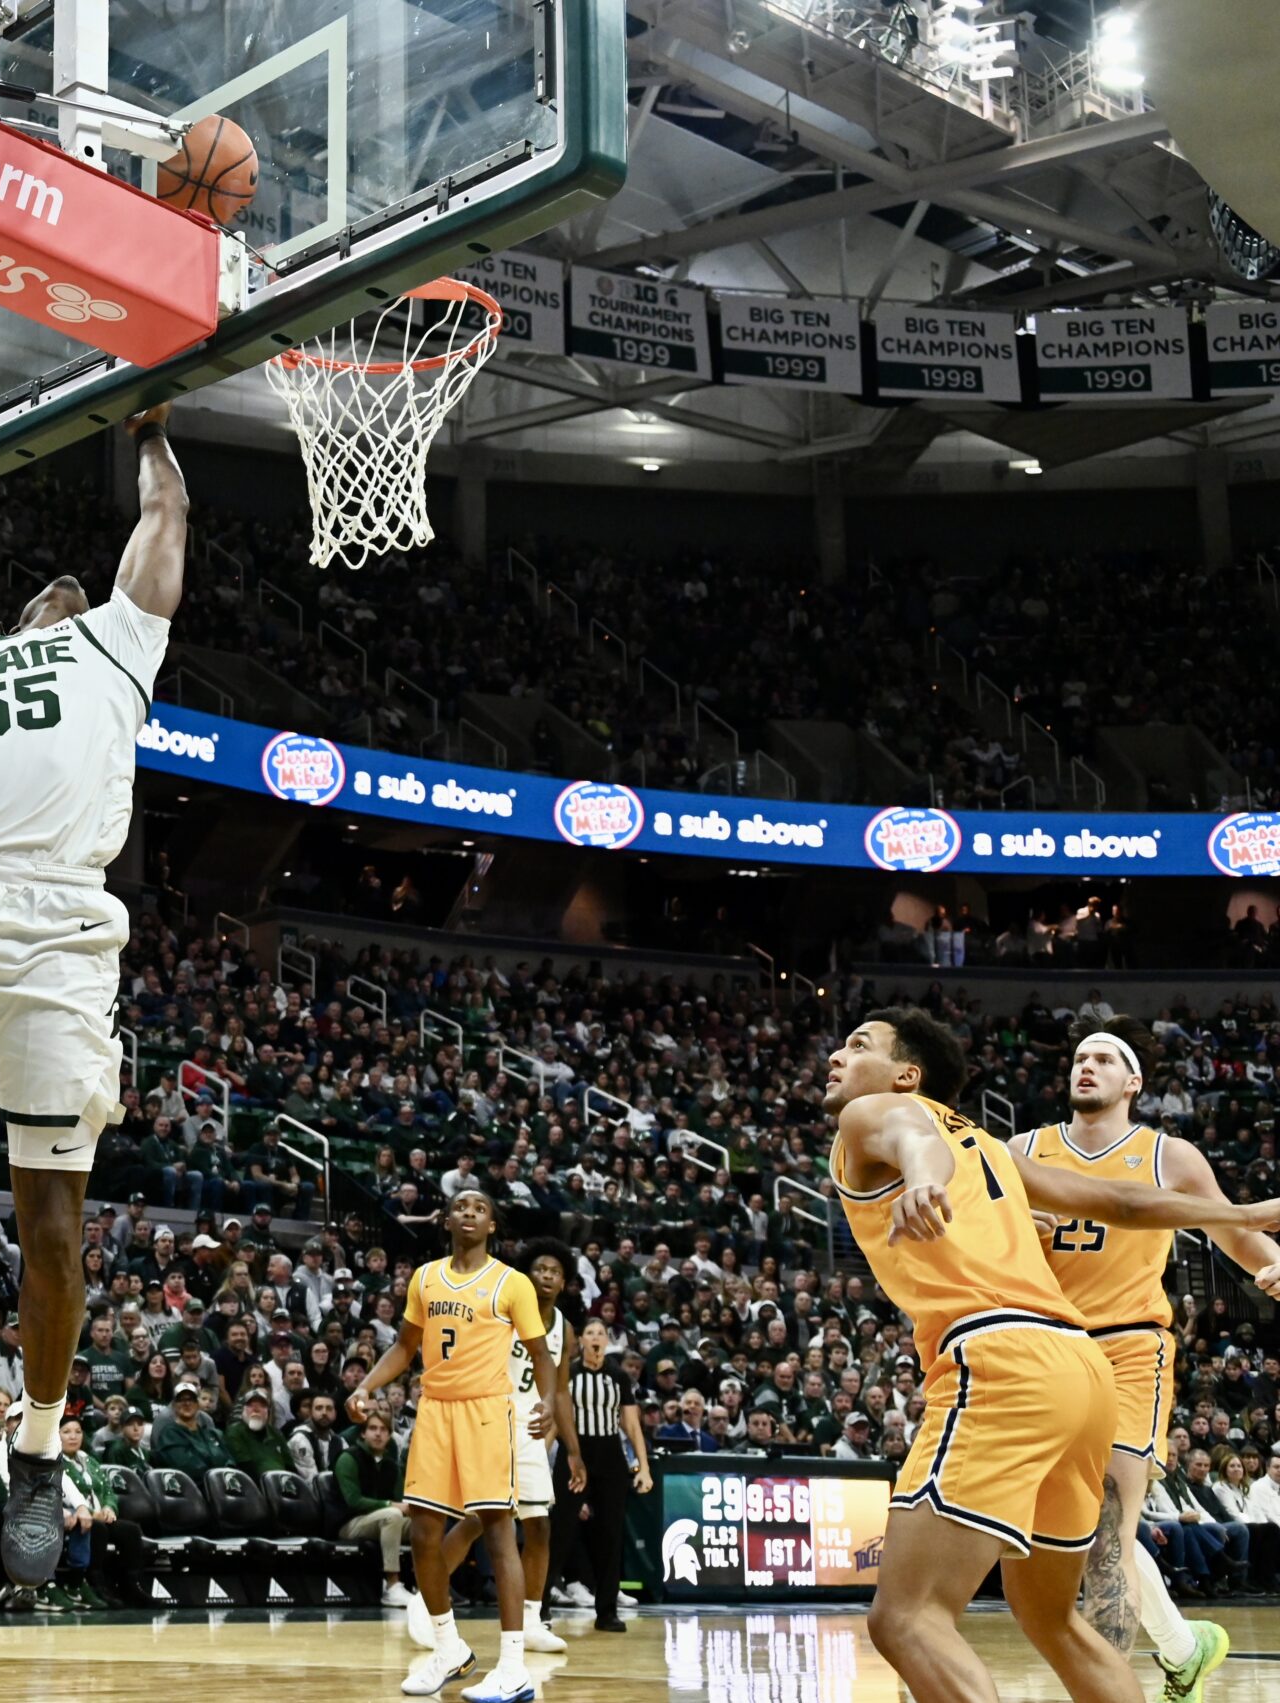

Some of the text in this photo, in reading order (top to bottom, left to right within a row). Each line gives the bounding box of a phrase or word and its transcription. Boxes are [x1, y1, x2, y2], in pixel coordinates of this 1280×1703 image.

[467, 257, 537, 282] IG TEN
[589, 294, 692, 325] TOURNAMENT
[749, 306, 832, 328] BIG TEN
[1238, 312, 1278, 330] BIG
[588, 311, 695, 343] CHAMPIONS
[726, 325, 857, 351] CHAMPIONS
[905, 316, 986, 337] BIG TEN
[1066, 318, 1155, 337] BIG TEN
[612, 337, 671, 366] 1999
[881, 337, 1013, 360] CHAMPIONS
[1041, 338, 1185, 359] CHAMPIONS
[765, 356, 820, 378] 1999
[921, 367, 977, 389] 1998
[1083, 368, 1145, 389] 1990
[274, 745, 332, 770] Jersey
[354, 771, 371, 795] a
[378, 772, 426, 804] sub
[654, 812, 672, 835] a
[679, 810, 731, 840] sub
[973, 833, 992, 856] a
[1001, 828, 1055, 857] sub
[1052, 1218, 1107, 1252] 25
[428, 1301, 474, 1323] ROCKETS
[441, 1328, 455, 1360] 2
[518, 1366, 534, 1393] 9
[701, 1476, 743, 1522] 29
[746, 1484, 810, 1523] 9:56
[764, 1539, 796, 1566] 1ST
